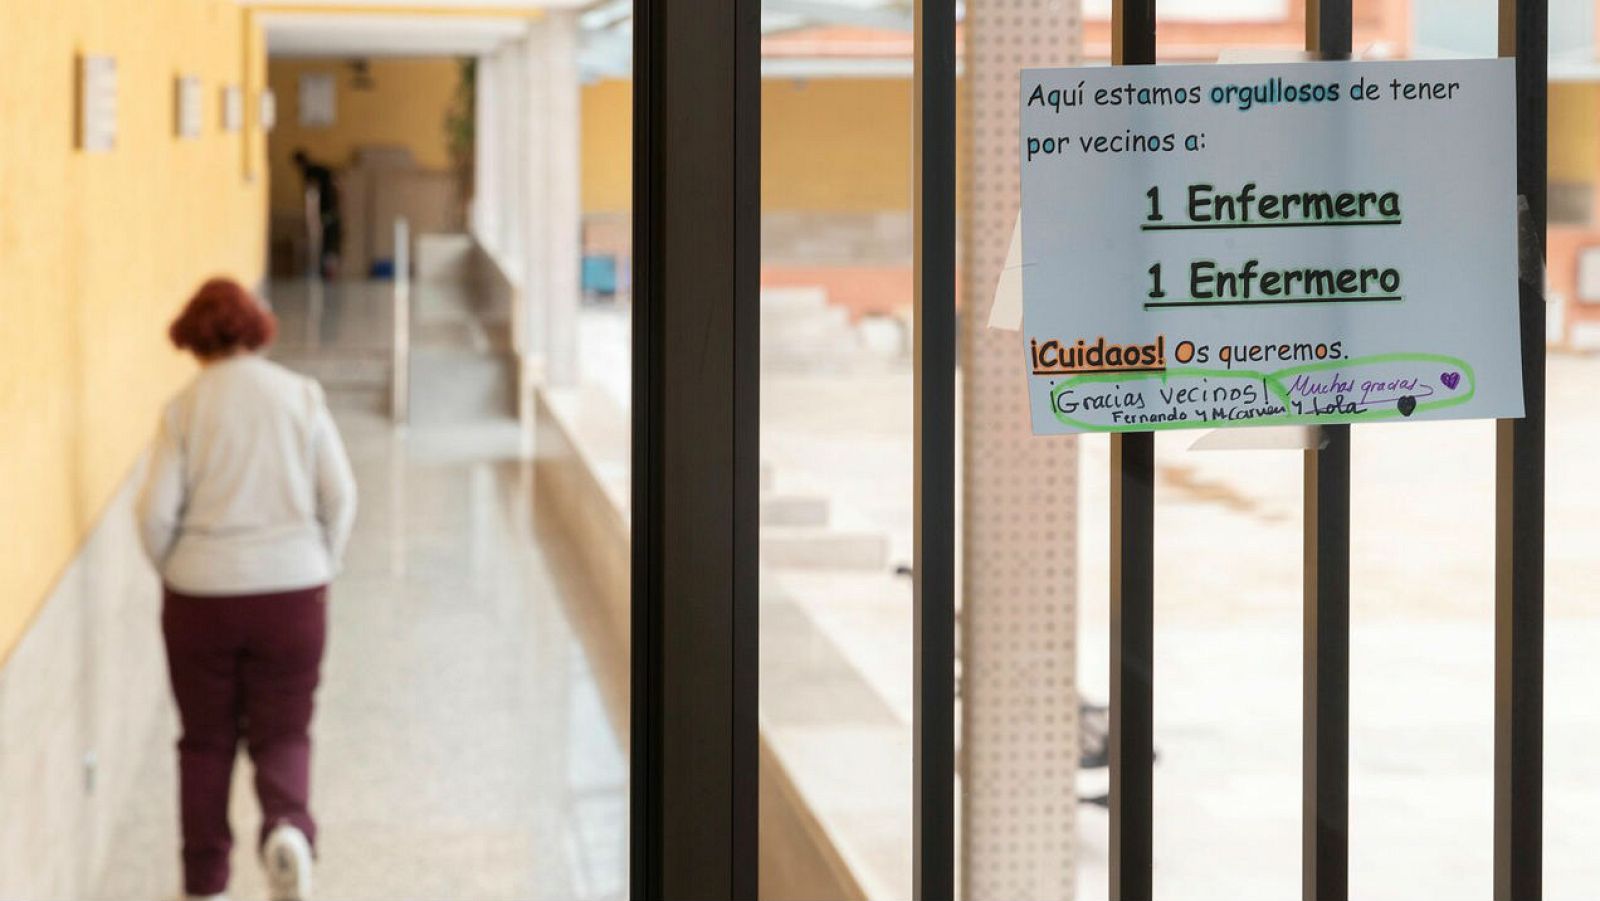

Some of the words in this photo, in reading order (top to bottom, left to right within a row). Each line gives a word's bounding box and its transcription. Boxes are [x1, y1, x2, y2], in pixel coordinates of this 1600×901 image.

[1027, 80, 1084, 113] Aquí
[1095, 83, 1201, 106] estamos
[1210, 77, 1340, 111] orgullosos
[1350, 77, 1381, 102] de
[1390, 78, 1460, 102] tener
[1026, 134, 1070, 161] por
[1079, 129, 1175, 155] vecinos
[1184, 130, 1206, 153] a:
[1145, 186, 1164, 222] 1
[1188, 183, 1401, 222] Enfermera
[1147, 263, 1166, 299] 1
[1190, 260, 1401, 299] Enfermero
[1031, 336, 1165, 370] ¡Cuidaos!
[1174, 340, 1210, 365] Os
[1218, 338, 1350, 369] queremos.
[1050, 380, 1146, 414] ¡Gracias
[1286, 373, 1354, 397] Muchas
[1360, 378, 1418, 404] gracias
[1112, 406, 1187, 424] Fernando
[1309, 394, 1367, 416] Lola
